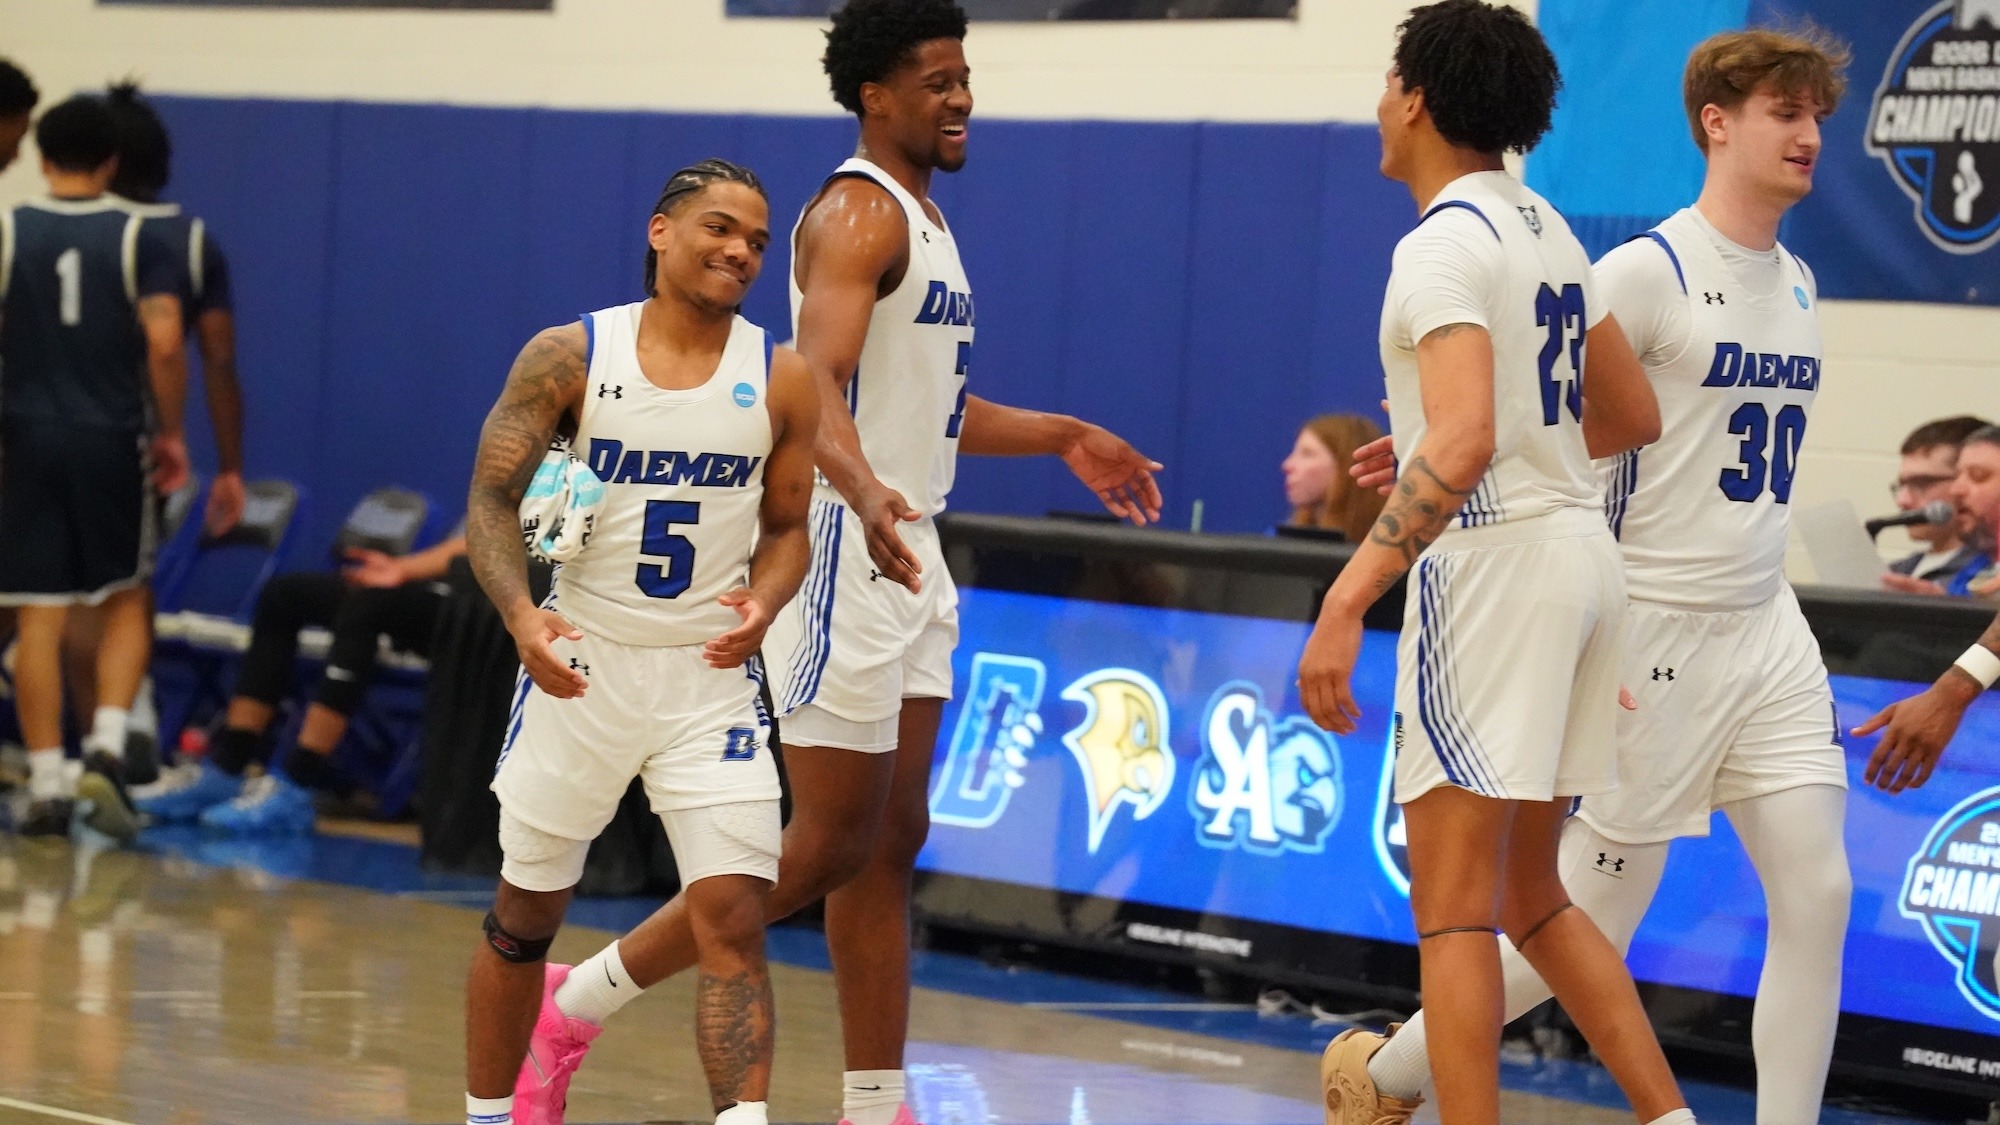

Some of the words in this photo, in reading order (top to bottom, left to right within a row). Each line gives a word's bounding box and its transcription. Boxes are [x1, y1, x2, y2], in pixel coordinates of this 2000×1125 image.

[55, 248, 82, 326] 1
[1535, 282, 1586, 426] 23
[1701, 342, 1821, 392] DAEMEN
[589, 437, 762, 488] DAEMEN
[1718, 402, 1807, 504] 30
[634, 499, 701, 600] 5
[1909, 864, 2000, 917] CHAM
